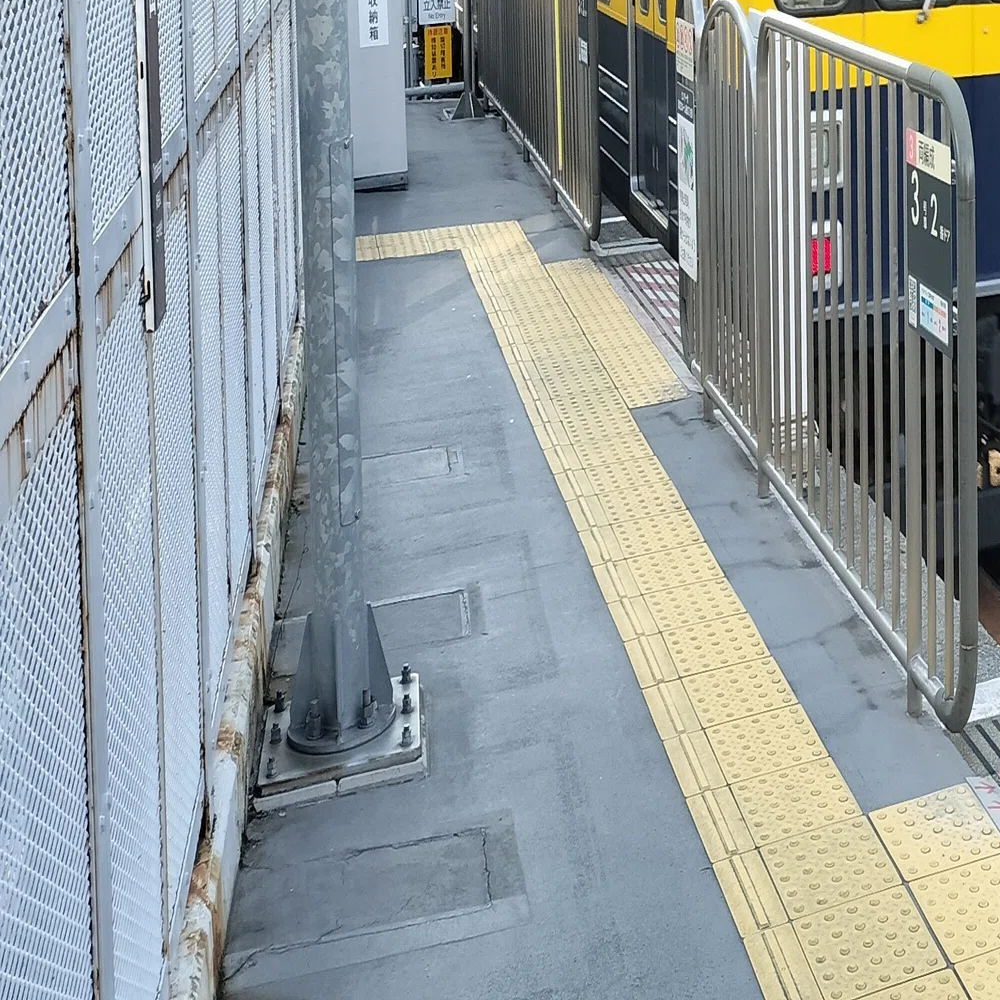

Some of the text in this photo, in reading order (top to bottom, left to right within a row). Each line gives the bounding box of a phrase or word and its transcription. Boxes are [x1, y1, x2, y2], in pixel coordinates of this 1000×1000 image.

[423, 0, 451, 11] 立入禁止
[911, 169, 919, 226] 3
[930, 193, 938, 238] 2
